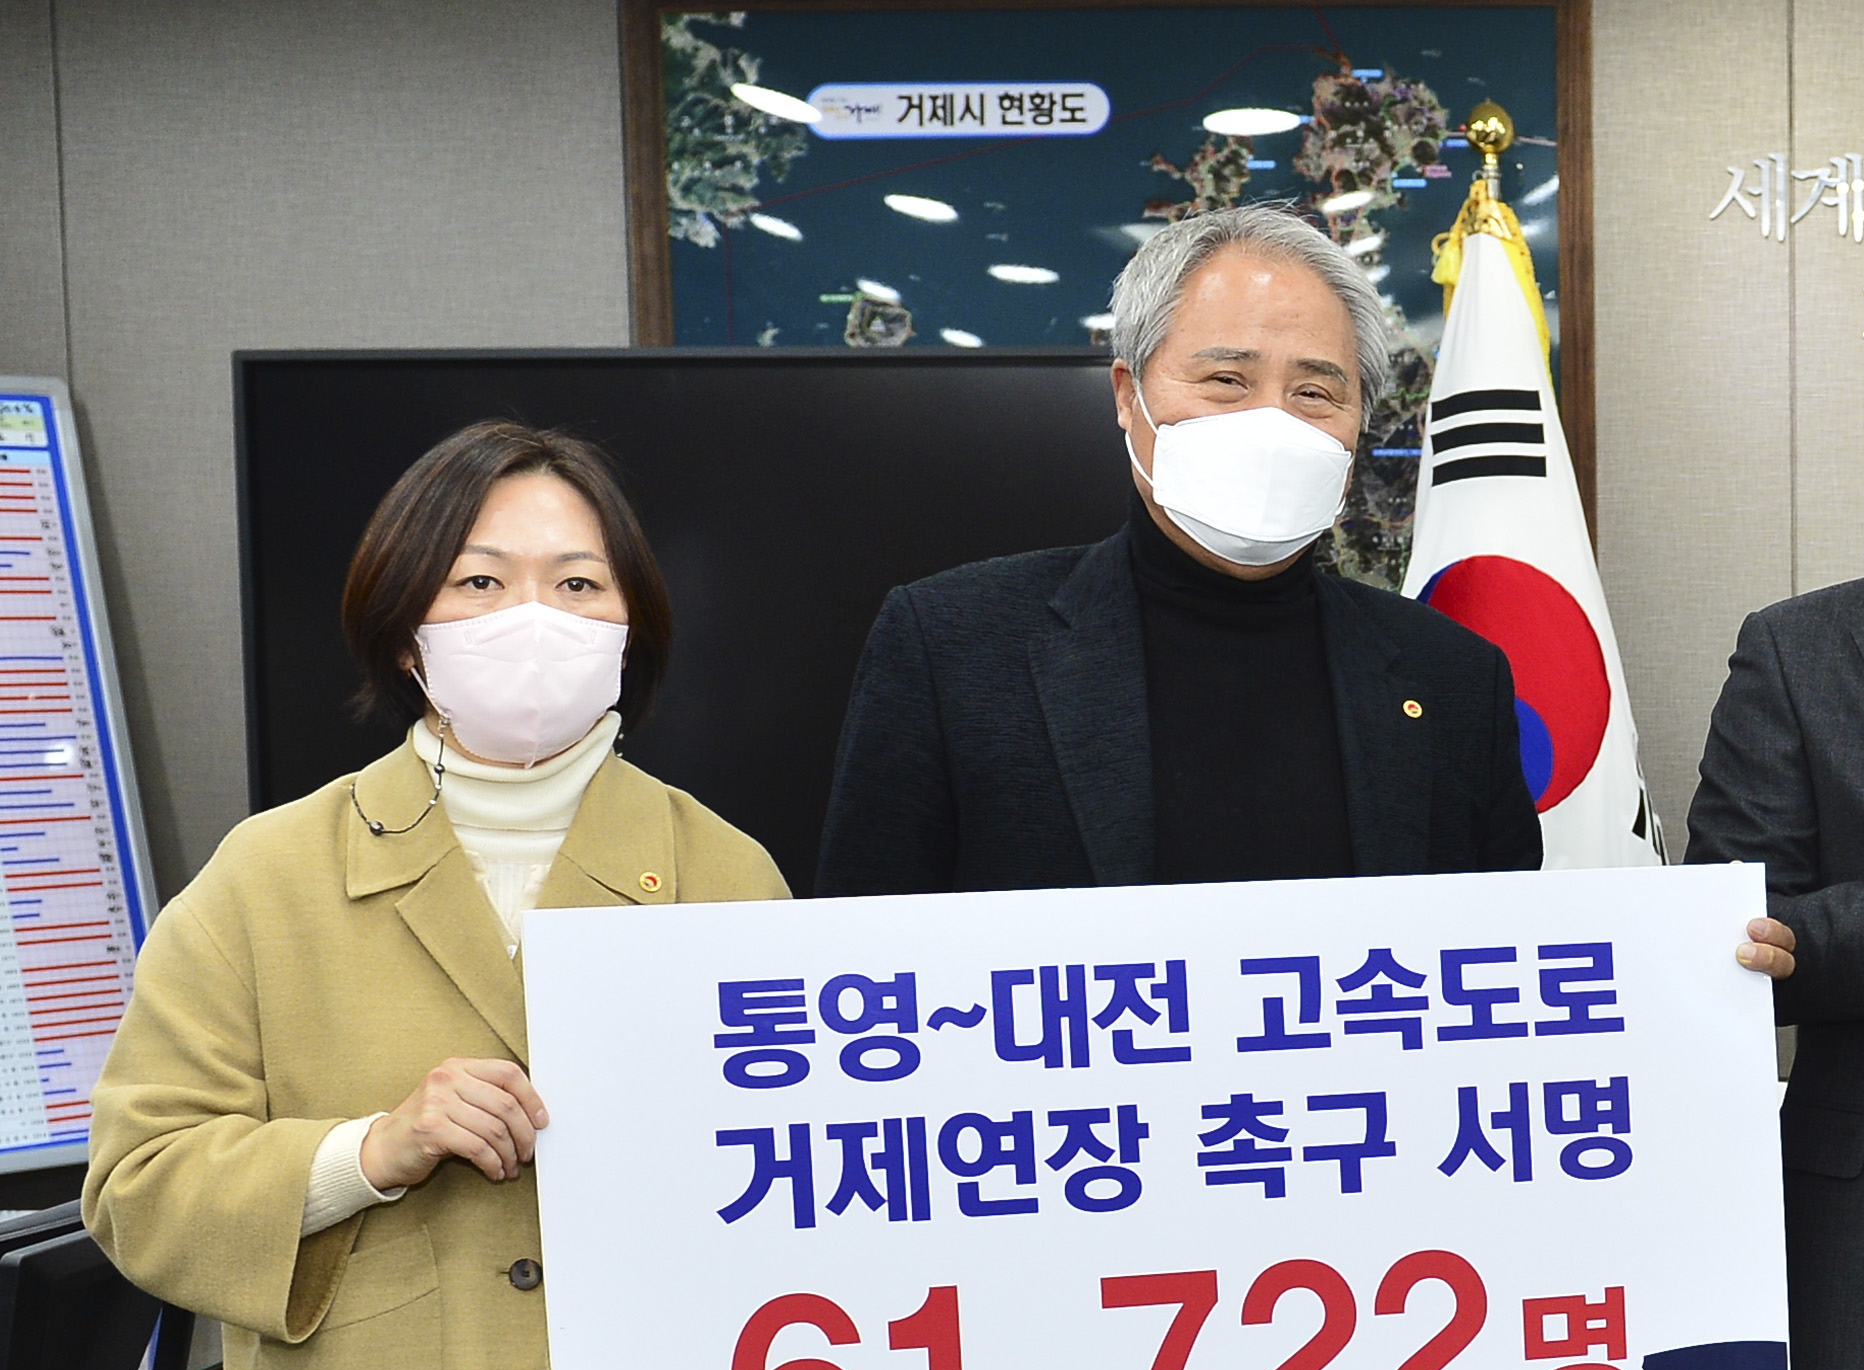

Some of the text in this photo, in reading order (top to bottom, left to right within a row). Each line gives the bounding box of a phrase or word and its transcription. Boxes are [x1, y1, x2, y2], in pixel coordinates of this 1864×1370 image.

[897, 93, 985, 127] 거제시
[997, 92, 1087, 126] 현황도
[714, 941, 1626, 1089] 통영~대전 고속도로
[715, 1075, 1634, 1230] 거제연장 촉구 서명
